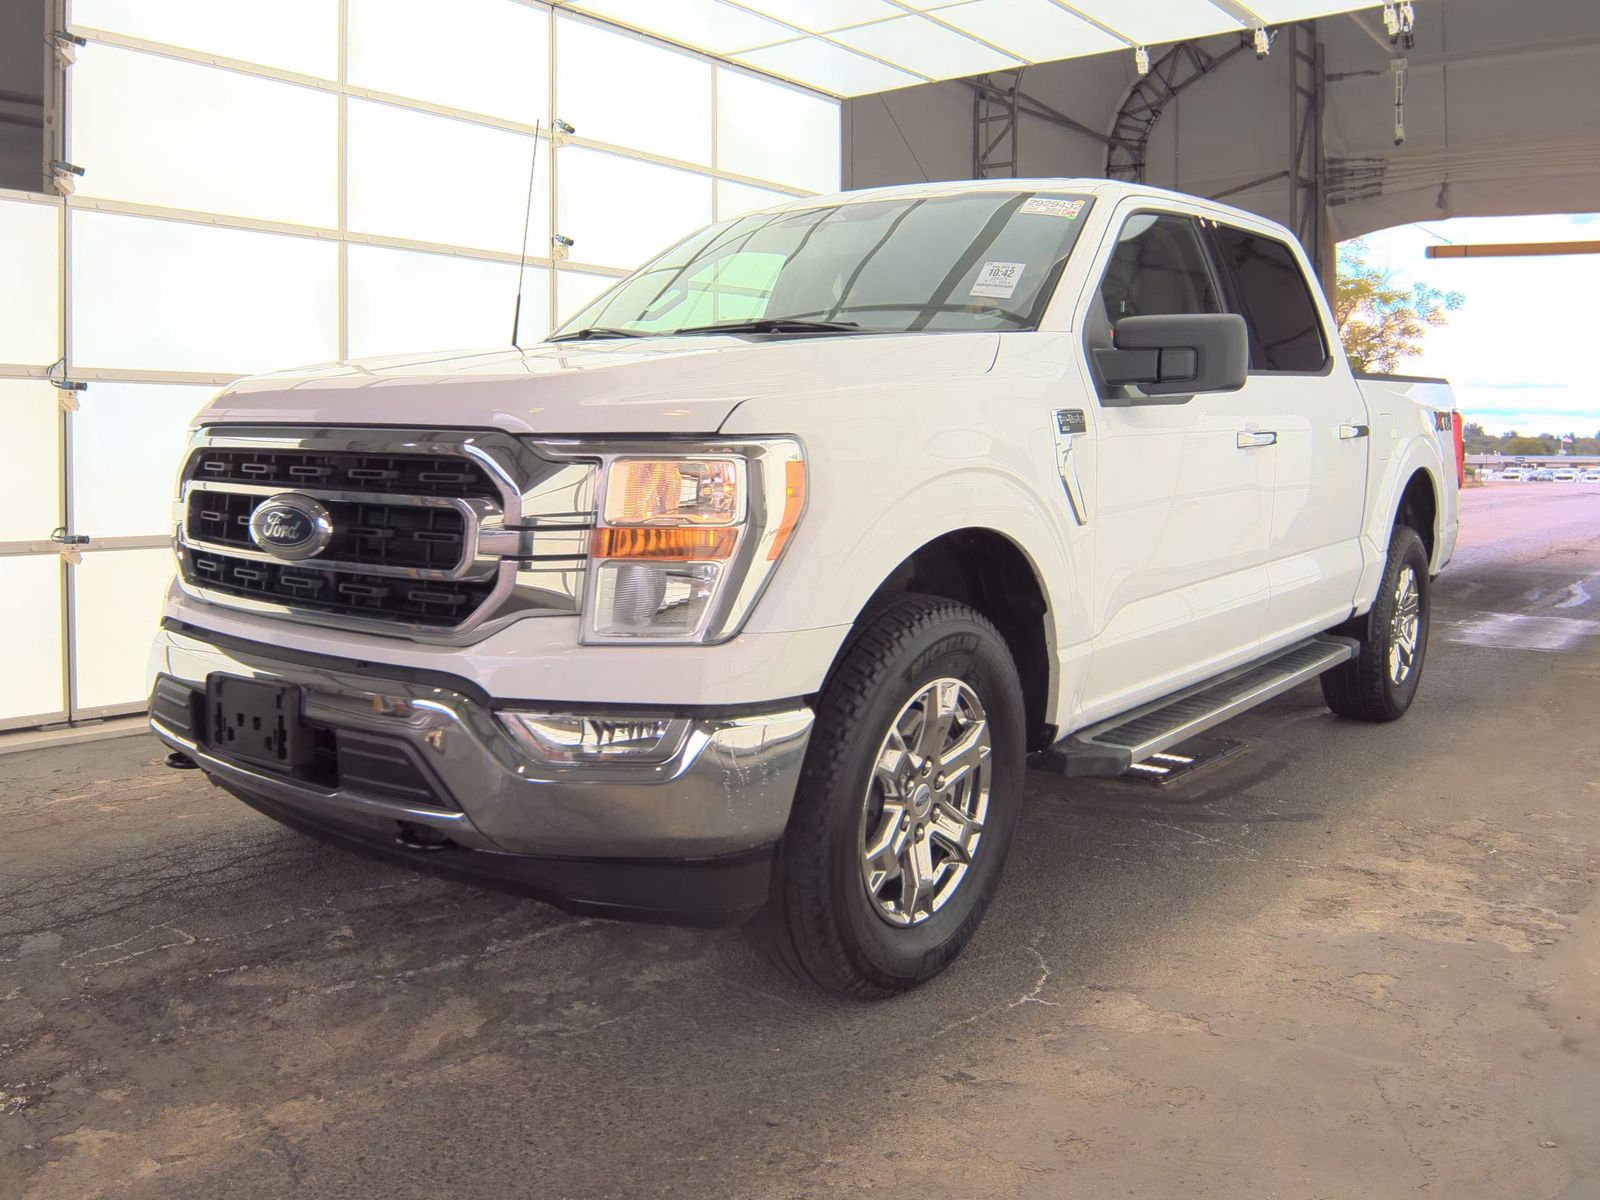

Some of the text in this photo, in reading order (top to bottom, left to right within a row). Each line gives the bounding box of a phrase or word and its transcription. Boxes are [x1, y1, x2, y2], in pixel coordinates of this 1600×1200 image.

[988, 268, 1015, 278] 10:42
[263, 511, 301, 539] Ford
[911, 635, 979, 678] MICHELIN
